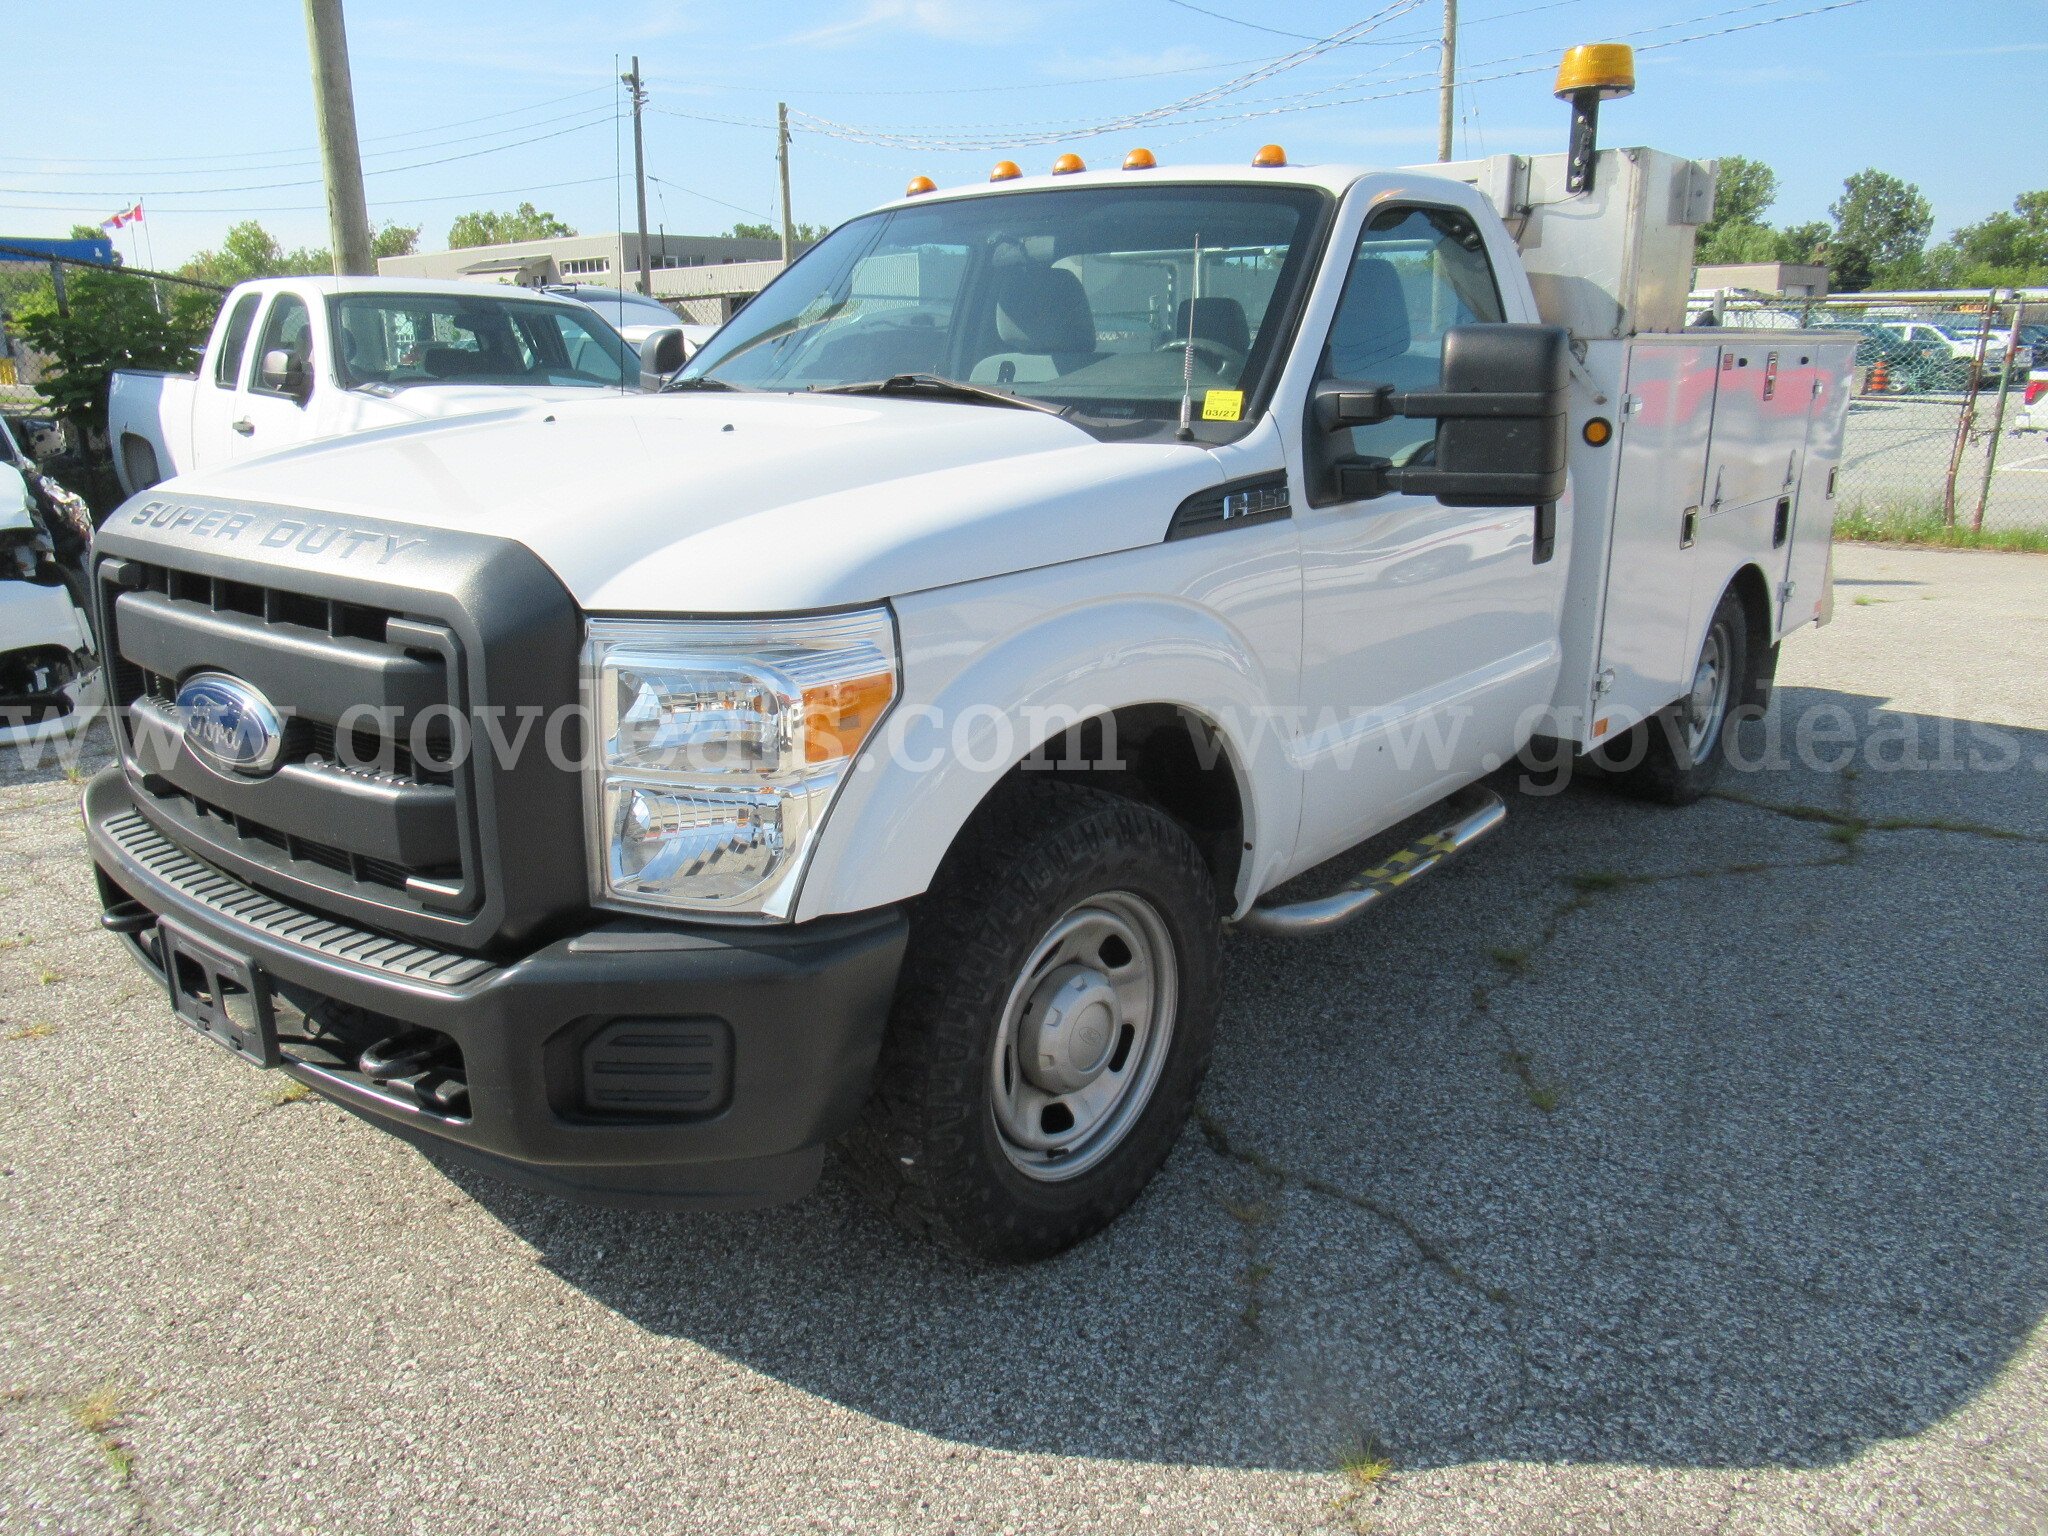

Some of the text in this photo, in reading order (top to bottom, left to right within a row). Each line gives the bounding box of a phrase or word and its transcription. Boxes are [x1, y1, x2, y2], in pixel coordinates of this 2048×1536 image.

[1205, 409, 1237, 418] 03/27
[130, 500, 428, 565] SUPER DUTY
[188, 693, 243, 751] Ford
